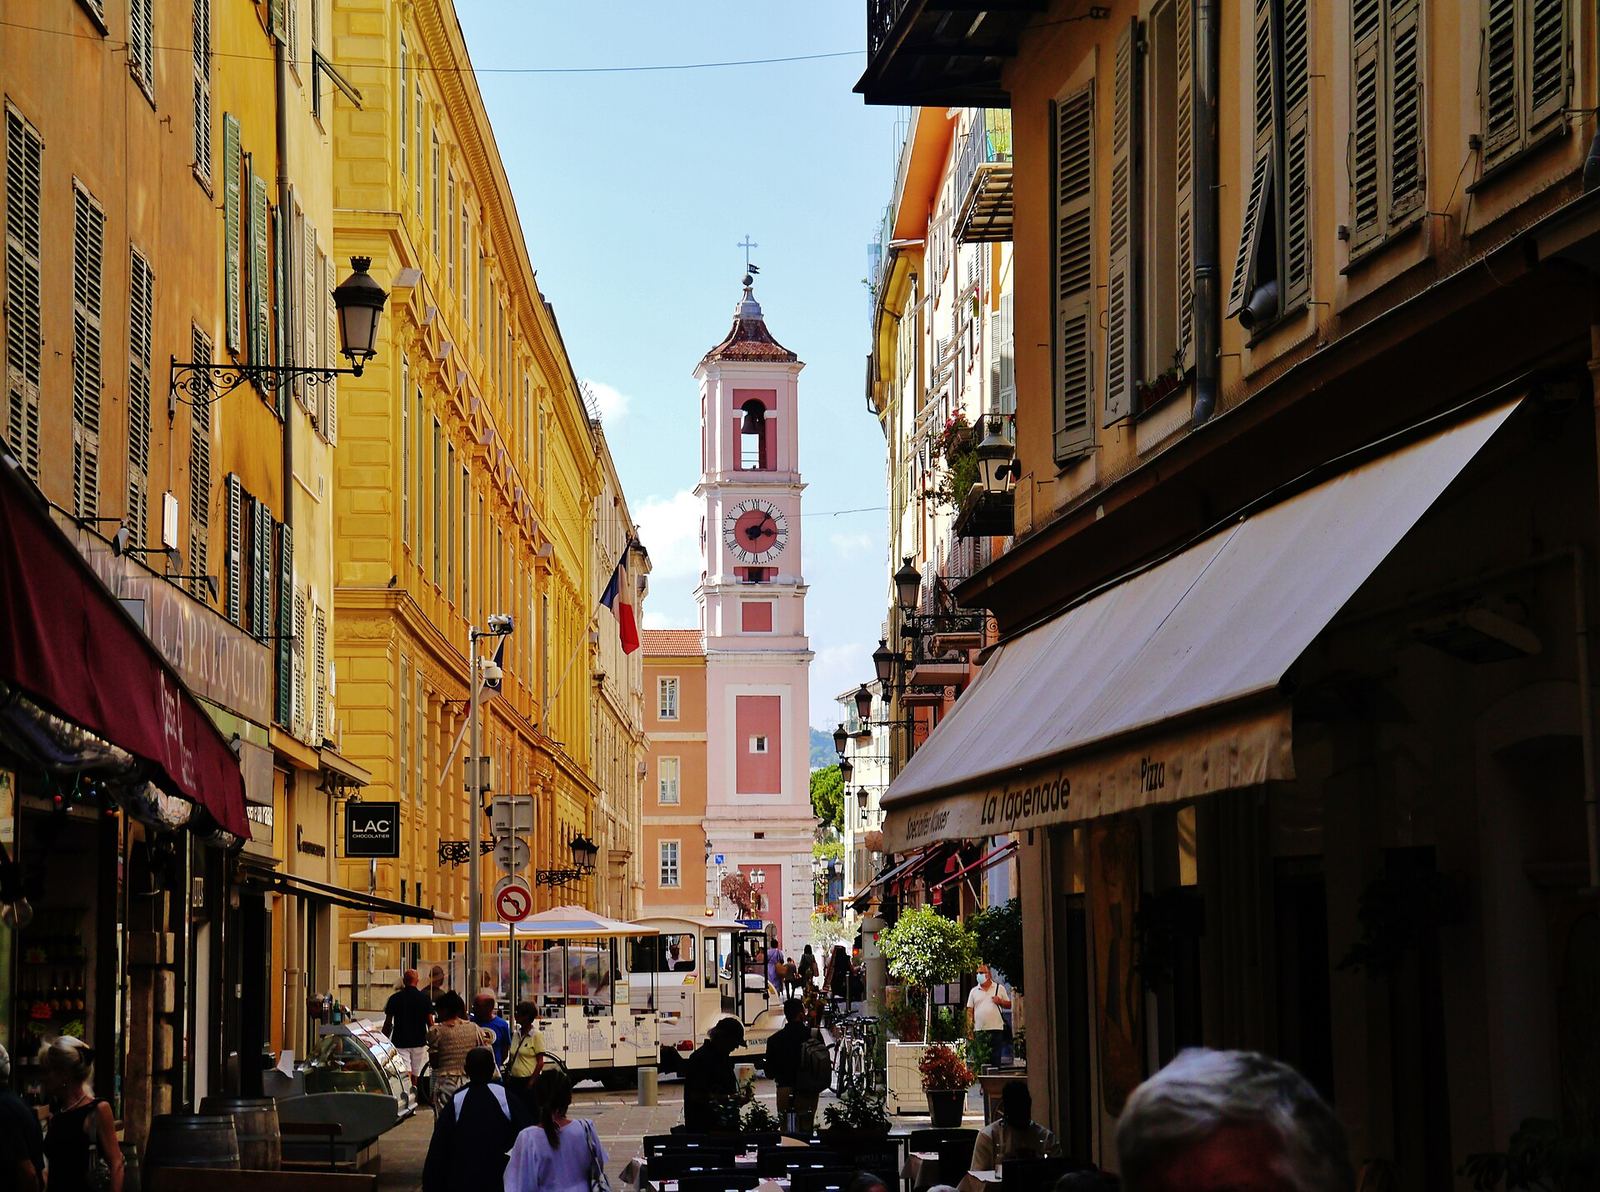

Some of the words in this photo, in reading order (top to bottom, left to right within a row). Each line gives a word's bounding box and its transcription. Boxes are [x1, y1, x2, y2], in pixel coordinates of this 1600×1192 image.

[160, 596, 267, 711] CAPRIOGLIO
[1140, 755, 1166, 793] Pizza
[352, 819, 390, 833] LAC
[981, 792, 998, 826] La
[1000, 773, 1071, 831] Tapenade
